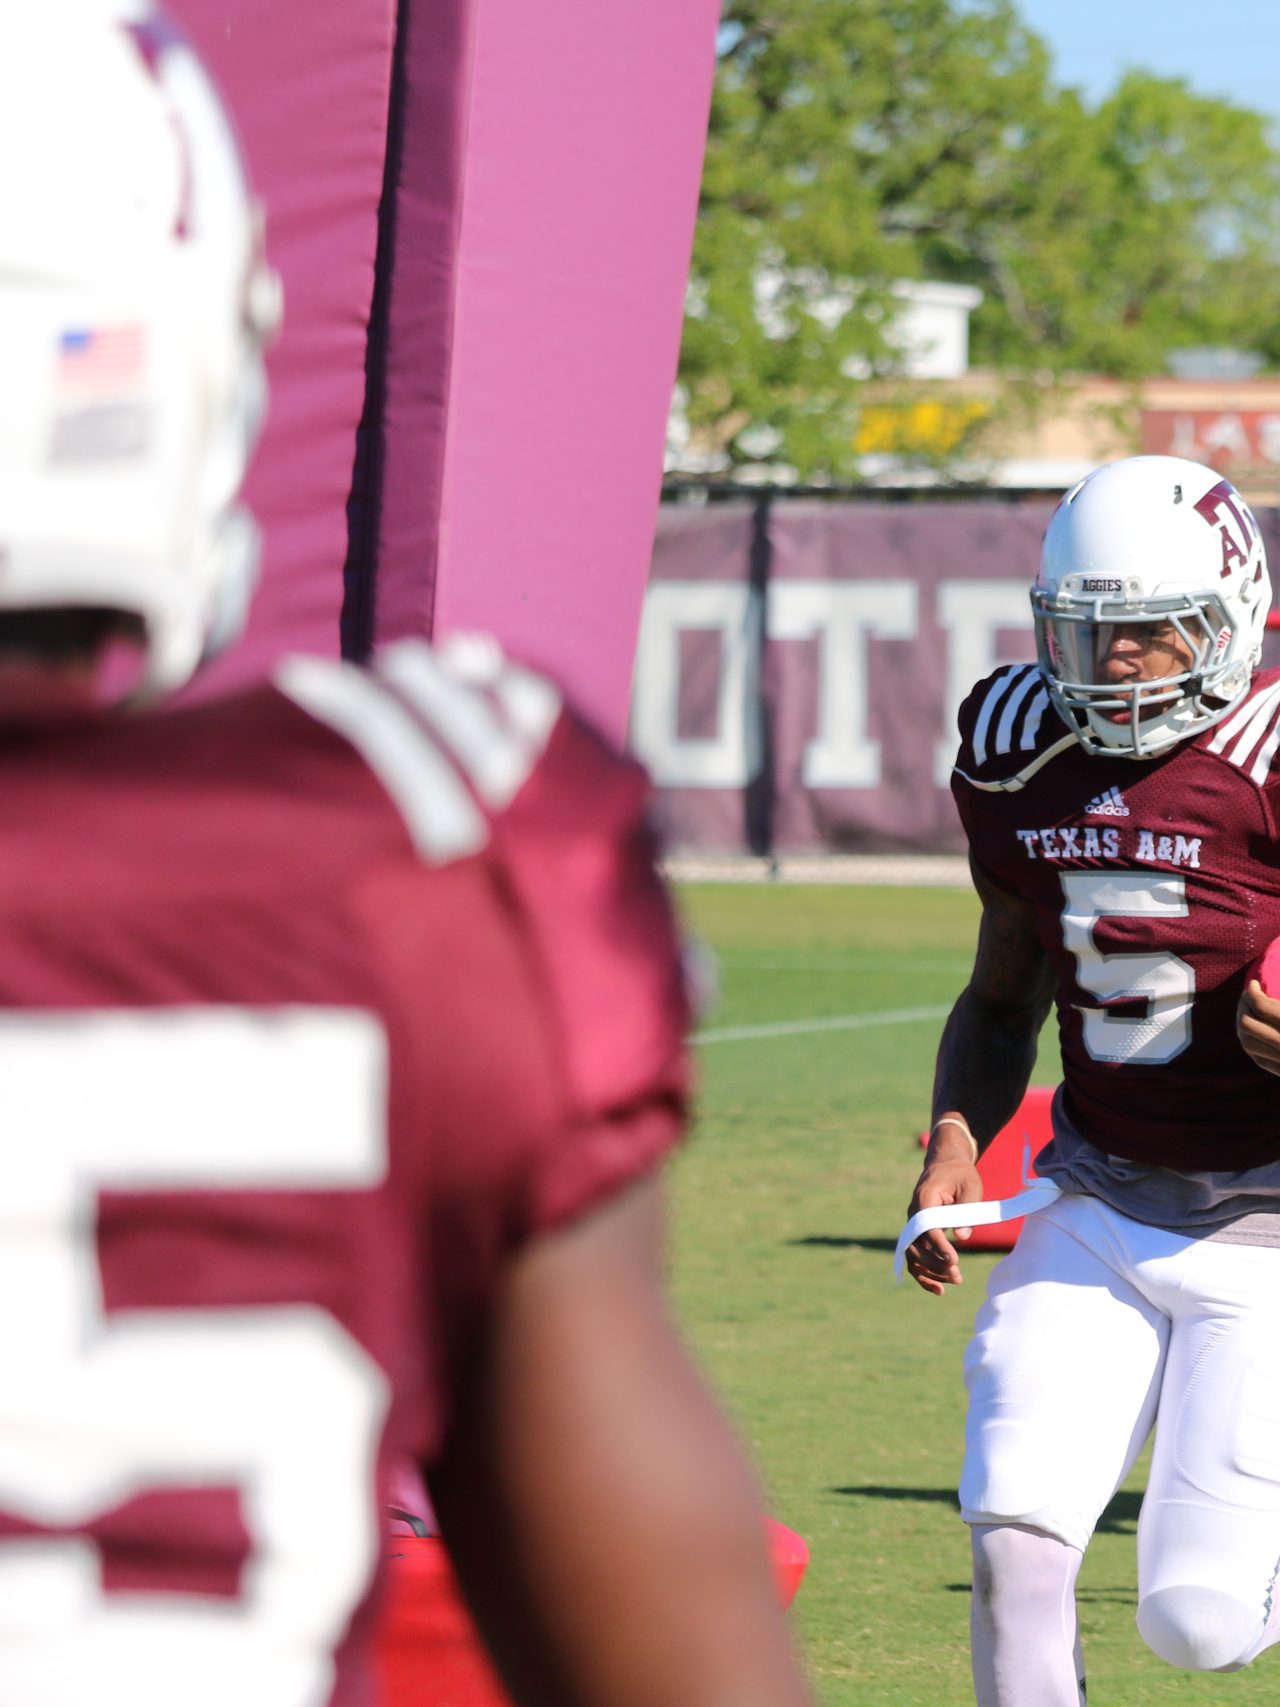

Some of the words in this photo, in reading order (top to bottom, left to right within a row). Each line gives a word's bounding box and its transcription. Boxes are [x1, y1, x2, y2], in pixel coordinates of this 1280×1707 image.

[1082, 579, 1122, 592] AGGIES
[1084, 801, 1130, 816] adidas
[1016, 827, 1121, 859] TEXAS
[1135, 830, 1202, 868] A&M
[1059, 870, 1198, 1066] 5
[0, 1002, 393, 1707] 5
